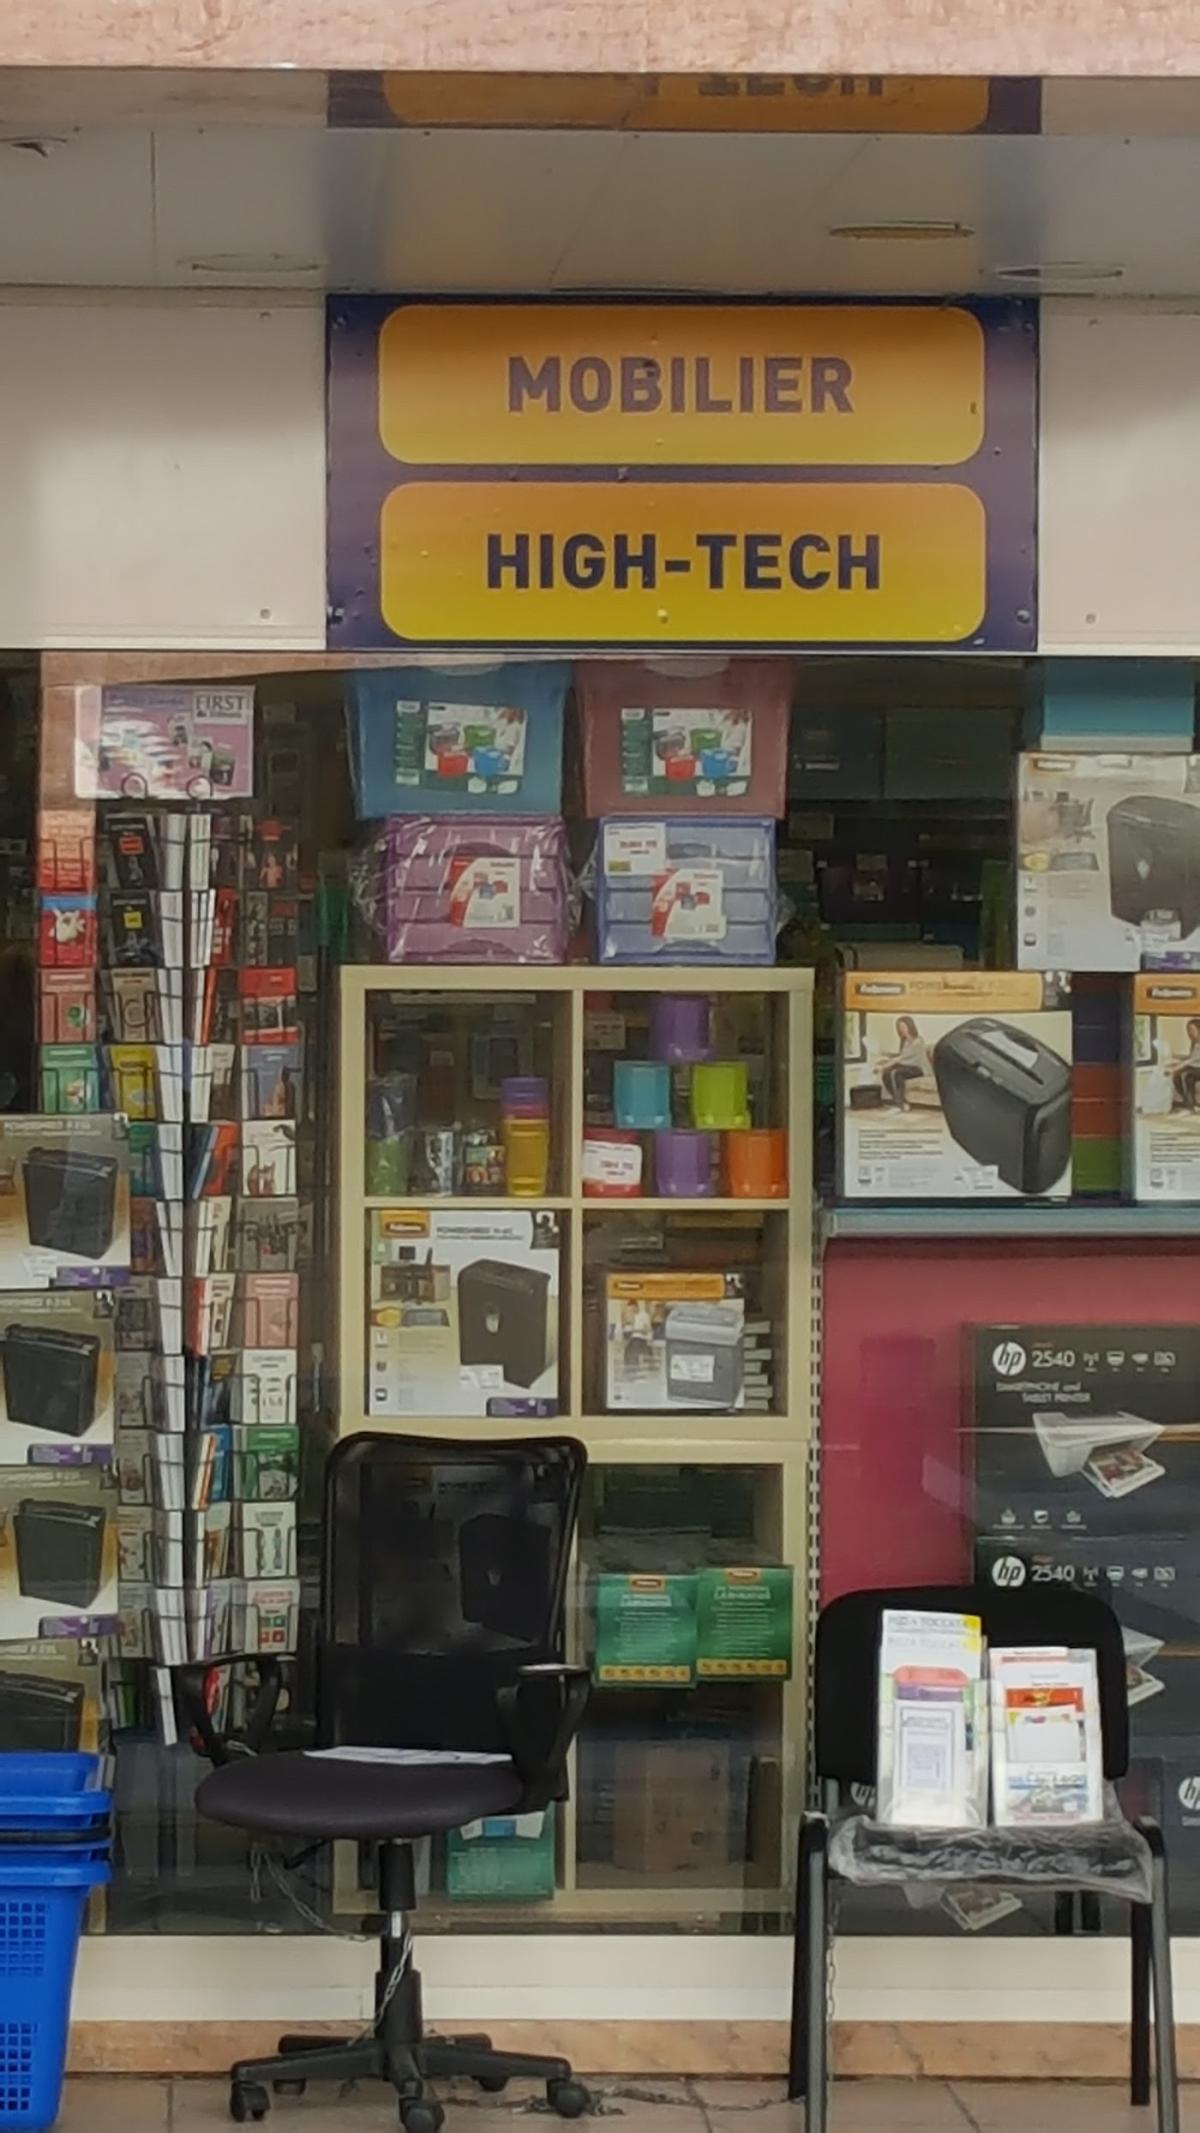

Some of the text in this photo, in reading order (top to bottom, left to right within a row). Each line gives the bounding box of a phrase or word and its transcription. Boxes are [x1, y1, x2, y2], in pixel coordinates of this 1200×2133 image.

[508, 356, 854, 413] MOBILIER
[487, 533, 881, 590] HIGH-TECH
[196, 695, 243, 710] FIRST
[994, 1343, 1076, 1376] hp 2540
[993, 1556, 1076, 1590] hp 2540
